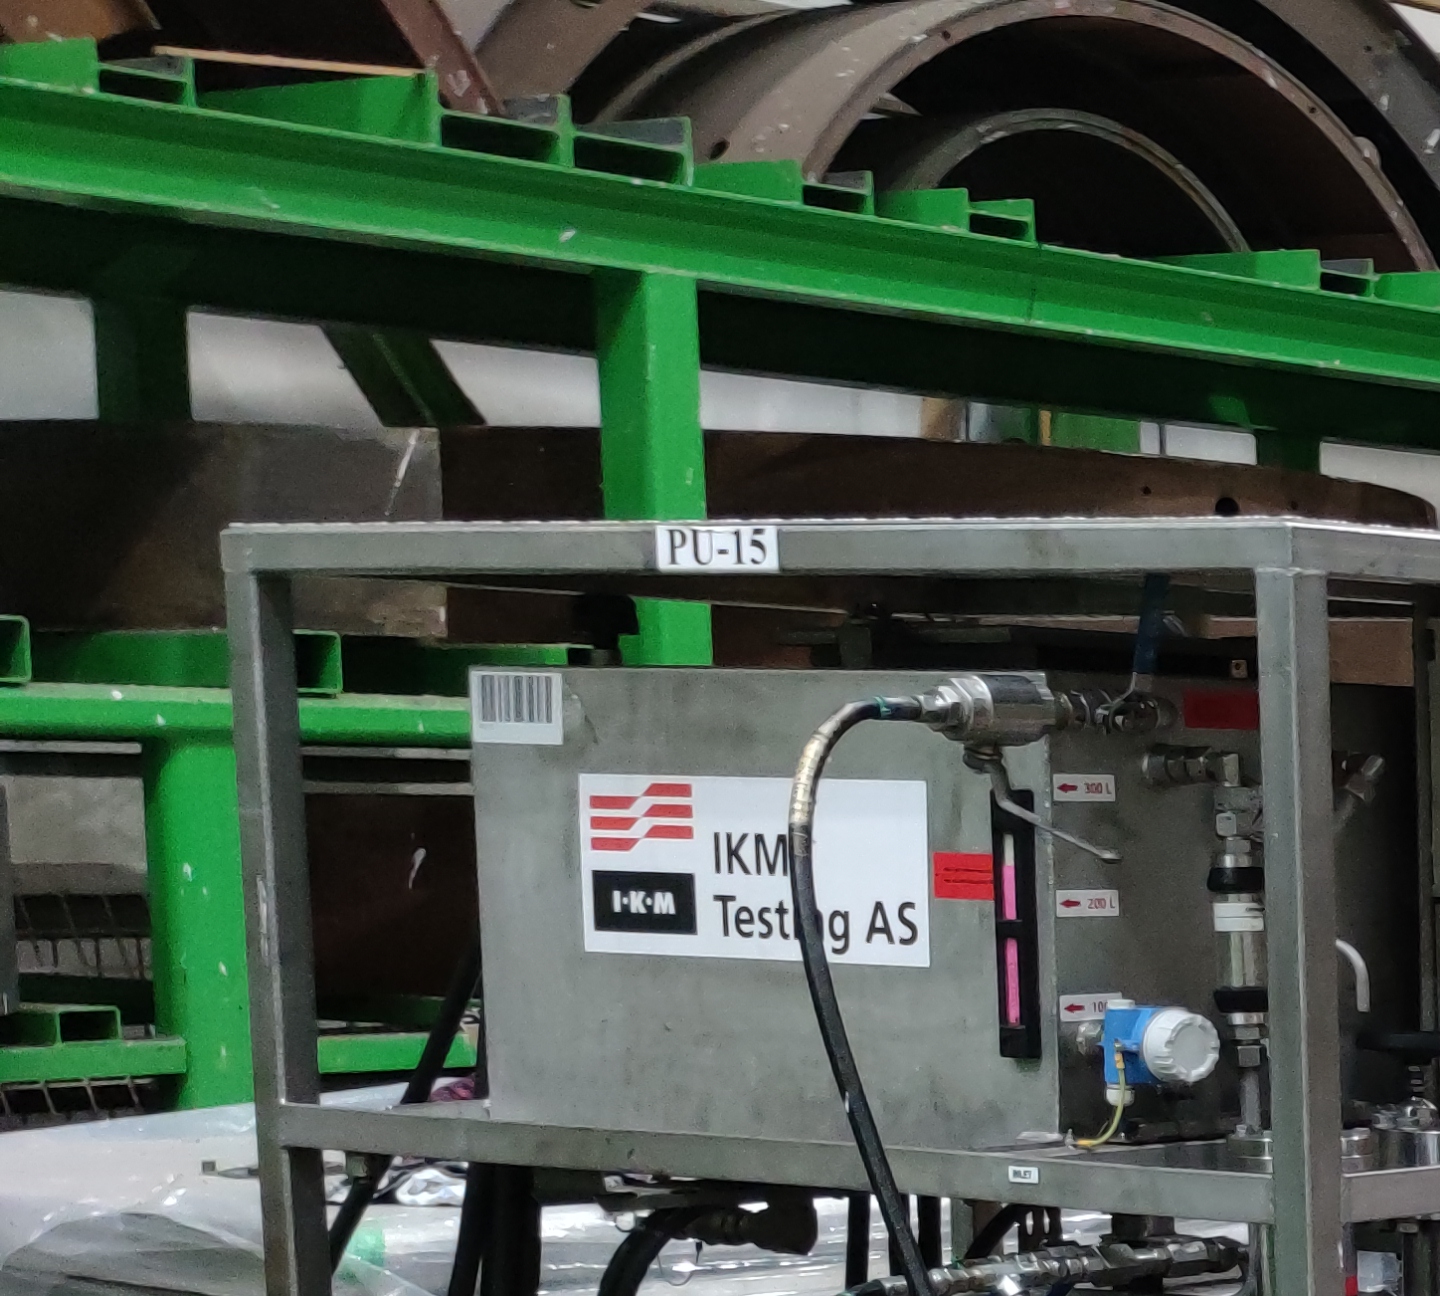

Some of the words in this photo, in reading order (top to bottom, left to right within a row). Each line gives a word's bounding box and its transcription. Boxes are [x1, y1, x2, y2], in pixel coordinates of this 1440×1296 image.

[666, 528, 767, 566] PU-15
[712, 831, 792, 877] IKM
[866, 900, 919, 945] AS
